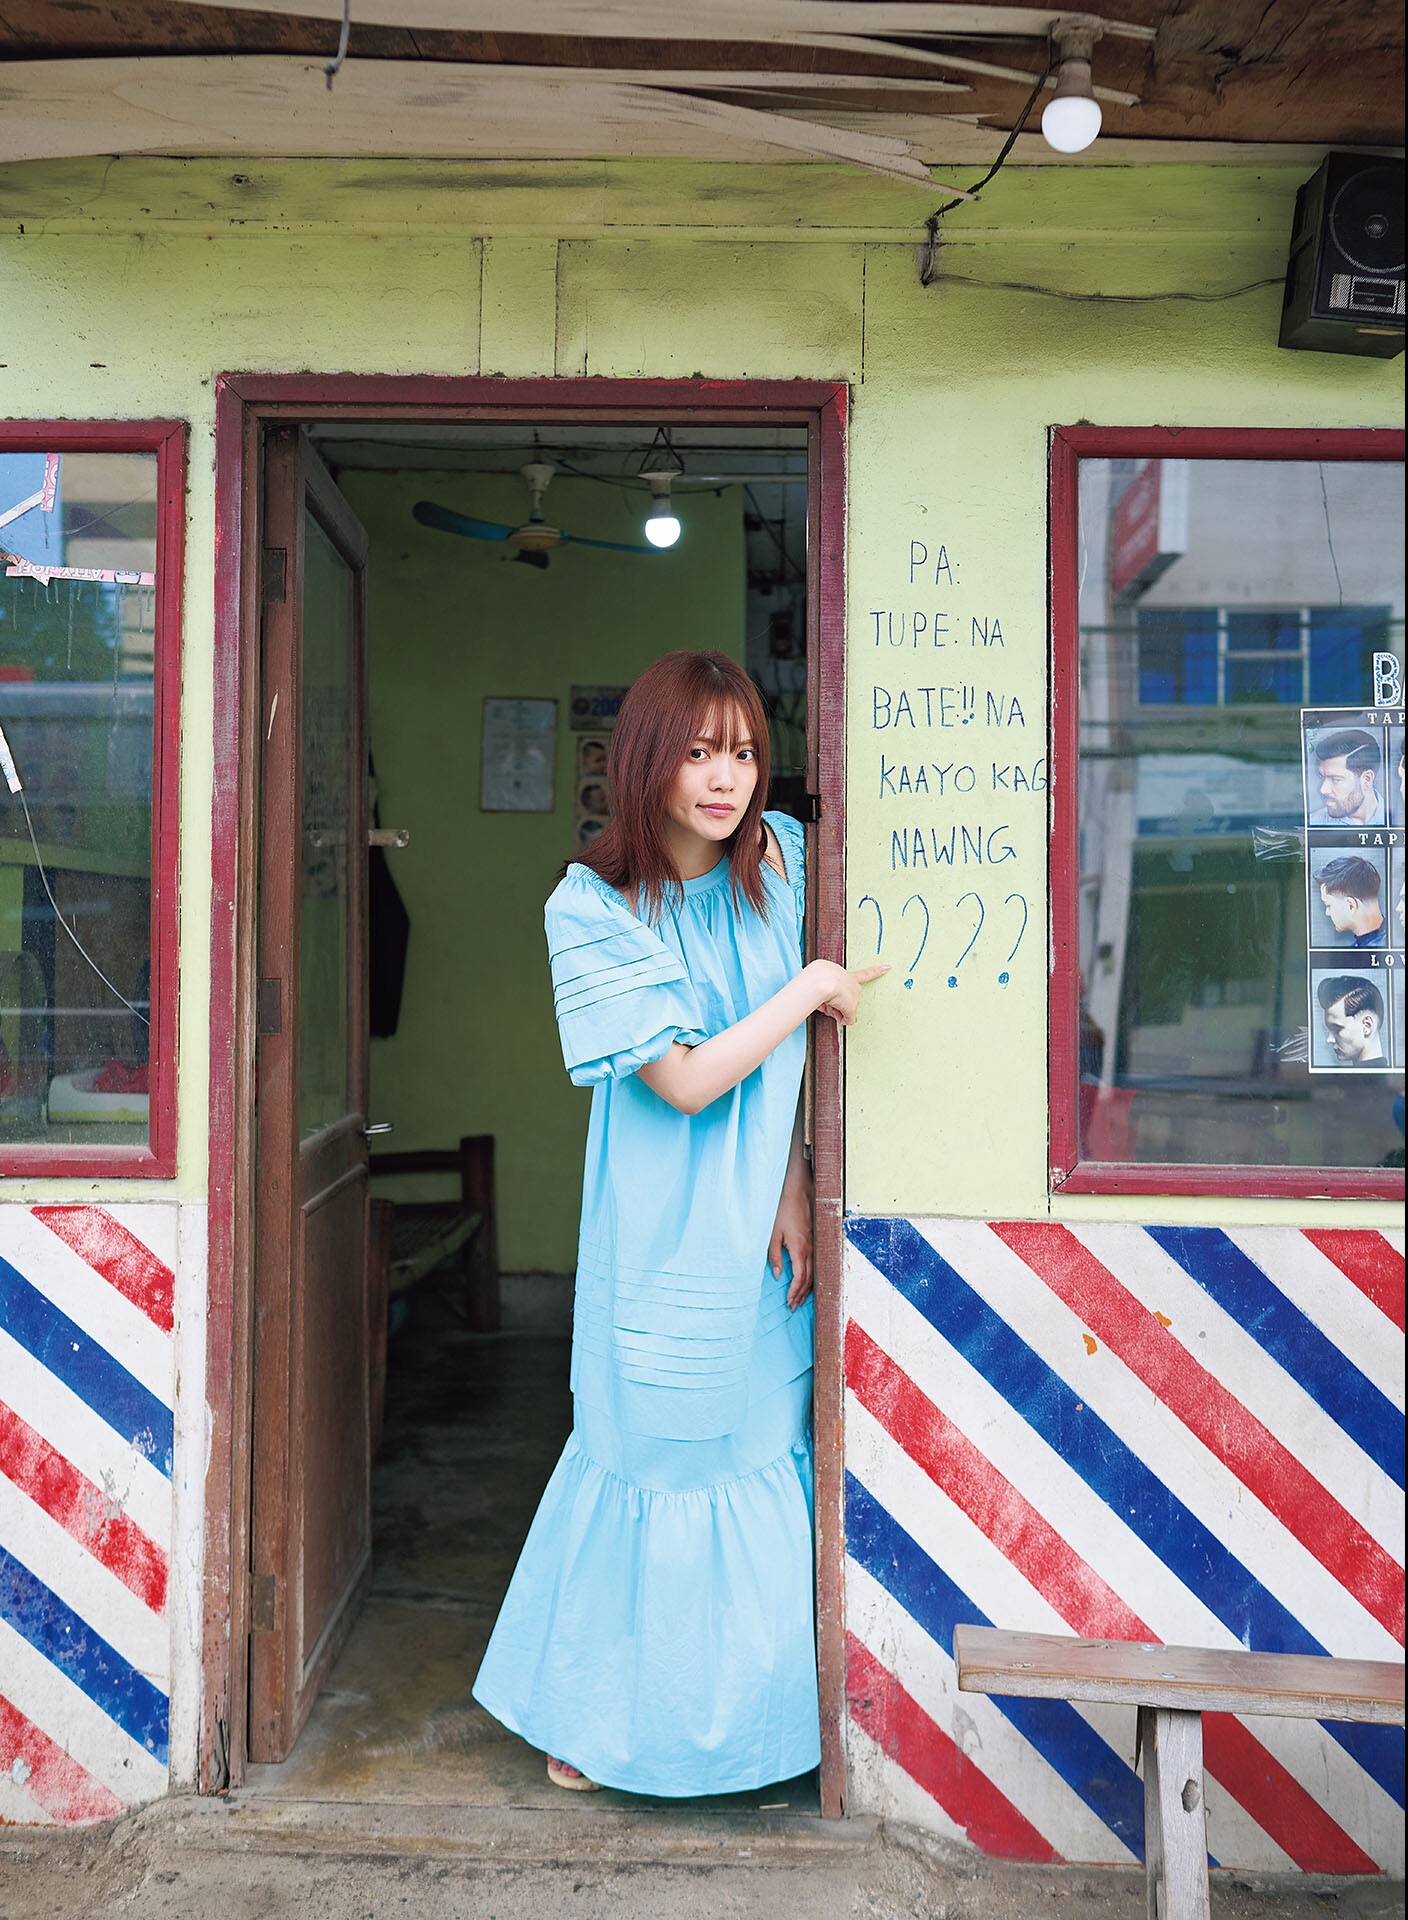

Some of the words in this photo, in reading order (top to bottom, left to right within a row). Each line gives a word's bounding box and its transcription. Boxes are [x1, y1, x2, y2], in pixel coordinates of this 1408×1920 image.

[972, 616, 1004, 647] NA
[1373, 652, 1405, 706] B
[986, 691, 1025, 727] NA
[879, 755, 976, 799] KAAYO
[892, 826, 1016, 870] NAWNG
[1358, 833, 1405, 845] TAP
